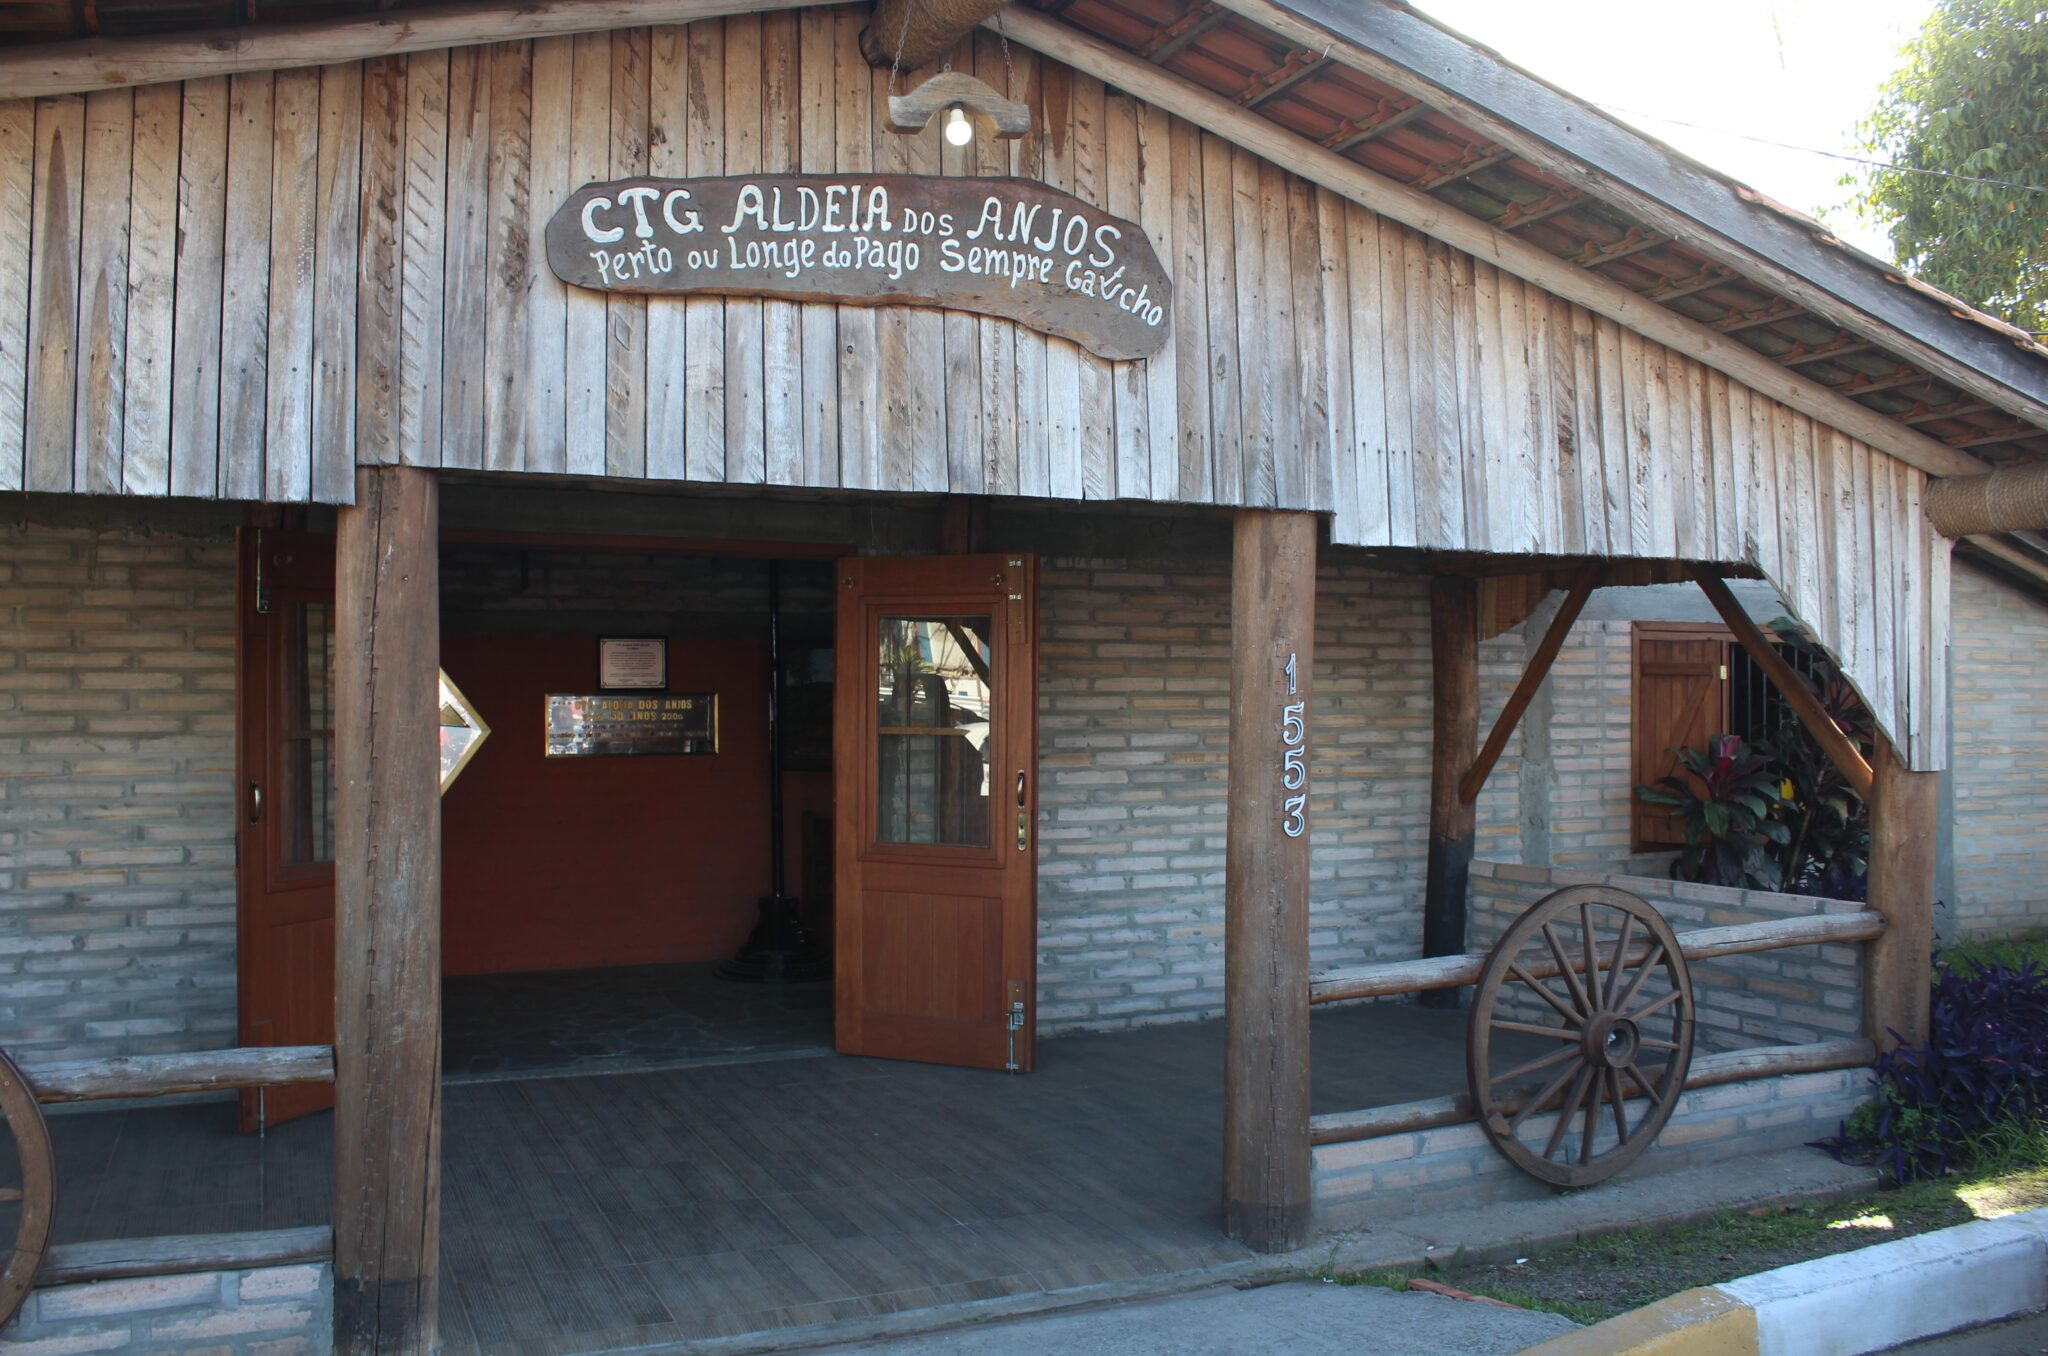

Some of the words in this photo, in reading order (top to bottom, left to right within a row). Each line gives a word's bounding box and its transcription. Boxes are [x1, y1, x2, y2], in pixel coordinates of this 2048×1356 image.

[581, 186, 704, 244] CTG
[721, 184, 892, 233] ALDEIA
[902, 208, 954, 236] DOS
[966, 196, 1121, 268] ANJOS
[590, 239, 673, 284] Perto
[687, 248, 718, 270] ou
[728, 236, 815, 279] Longe
[822, 241, 852, 268] do
[853, 236, 919, 280] Pago
[940, 239, 1054, 289] Sempre
[639, 699, 658, 710] DOS
[664, 699, 693, 710] ANJOS
[1283, 653, 1306, 837] 1553
